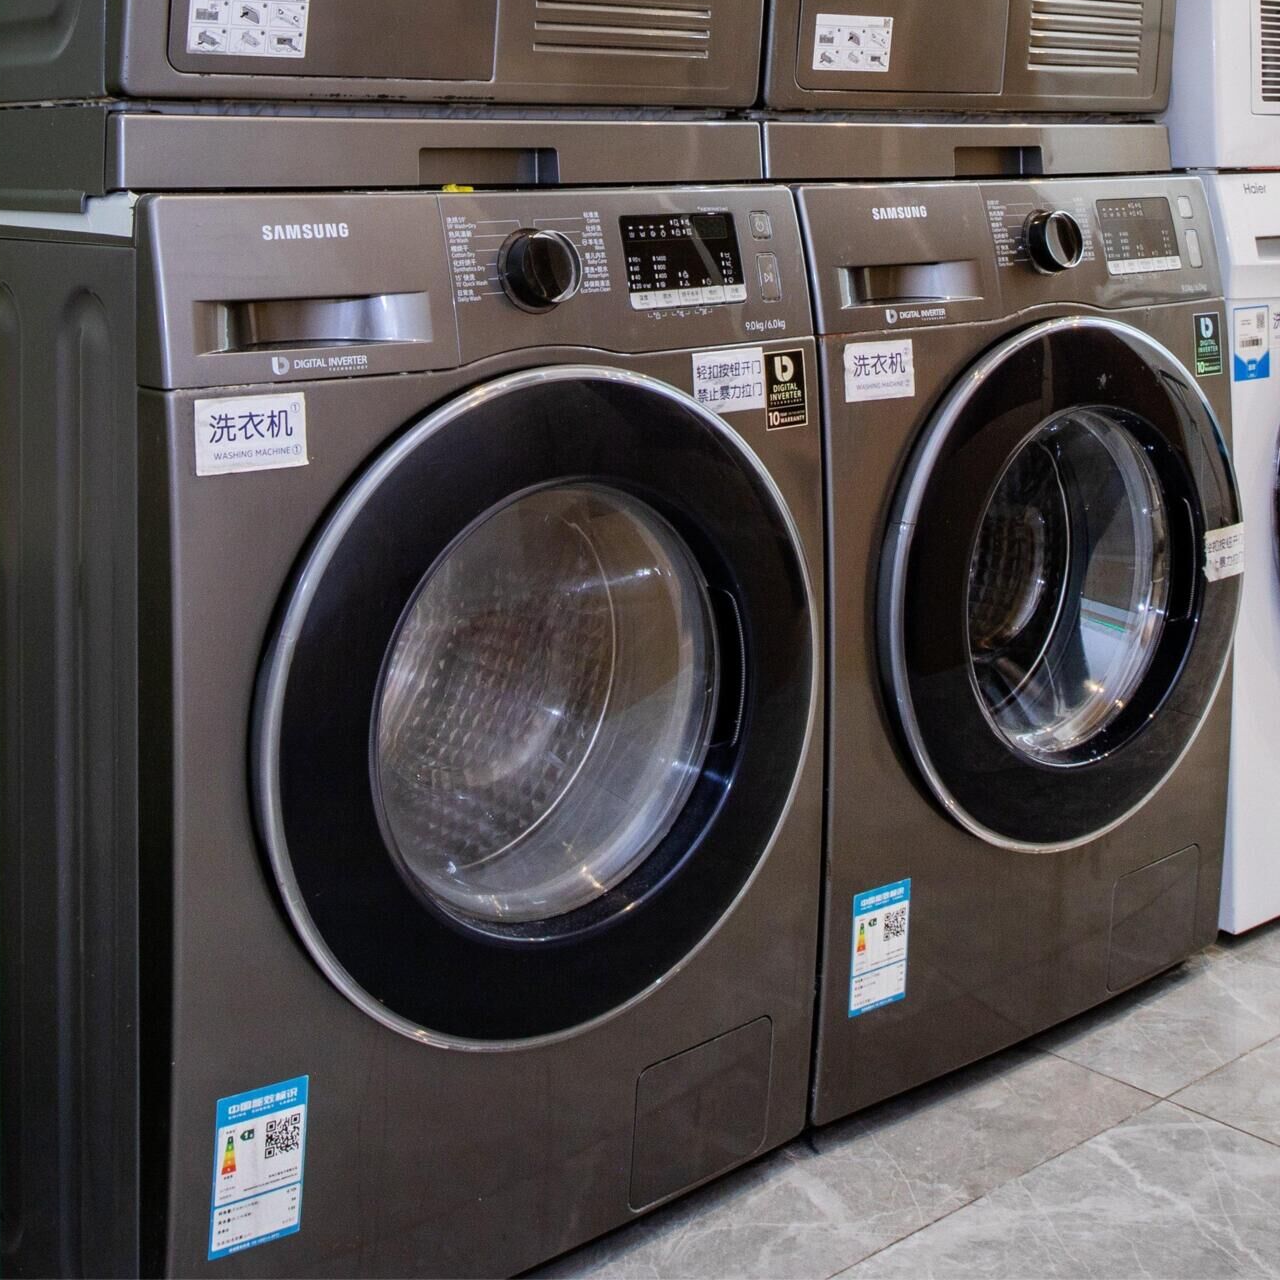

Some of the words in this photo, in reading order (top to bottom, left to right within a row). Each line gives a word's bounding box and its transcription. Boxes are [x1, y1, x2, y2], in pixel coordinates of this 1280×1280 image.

[1243, 184, 1267, 194] Haier
[872, 205, 928, 220] SAMSUNG
[262, 223, 349, 241] SAMSUNG
[899, 310, 921, 320] DIGITAL
[294, 357, 326, 369] DIGITAL
[328, 355, 368, 367] INVERTER
[853, 353, 906, 377] 洗衣机
[696, 360, 761, 380] 轻扣按钮开门
[697, 382, 762, 403] 禁止暴力拉门
[770, 389, 802, 401] INVERTER
[773, 383, 798, 393] DIGITAL
[768, 411, 780, 426] 10
[209, 409, 293, 444] 洗衣机
[214, 448, 253, 461] WASHING
[255, 447, 291, 459] MACHINE
